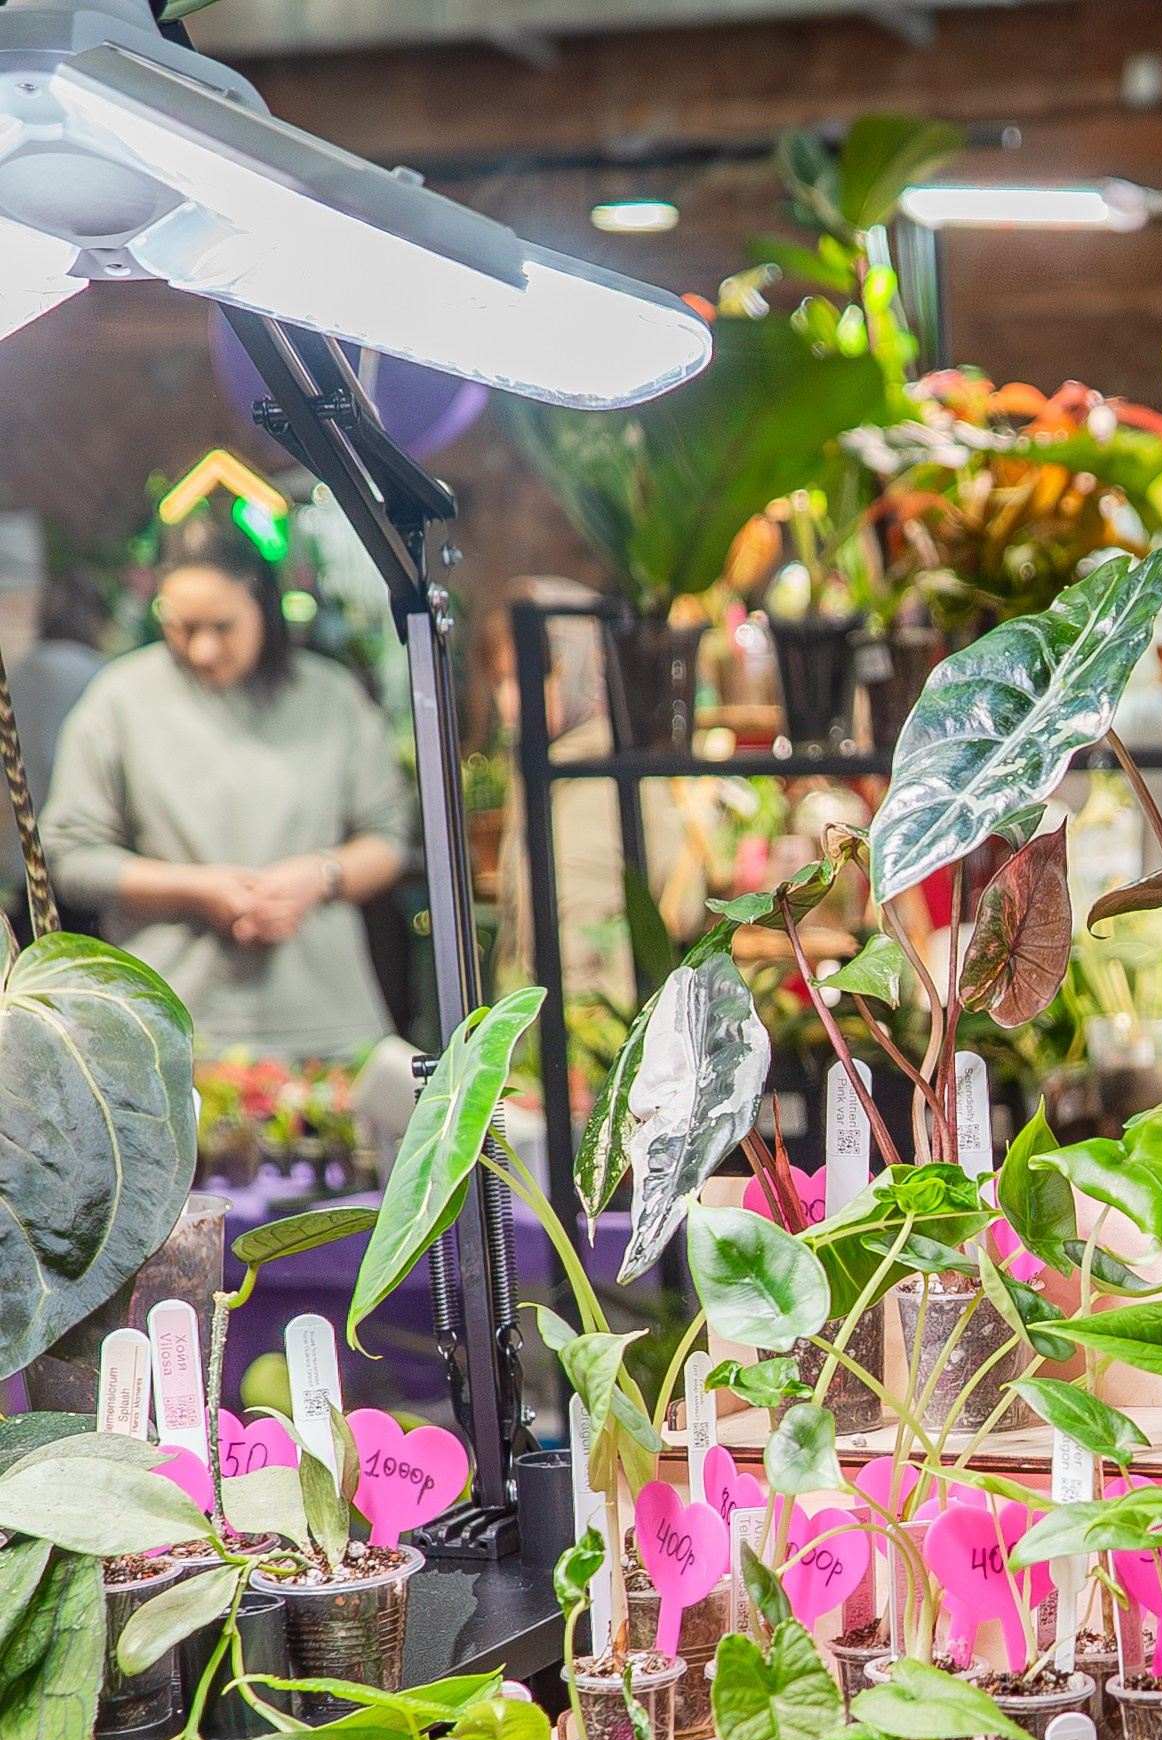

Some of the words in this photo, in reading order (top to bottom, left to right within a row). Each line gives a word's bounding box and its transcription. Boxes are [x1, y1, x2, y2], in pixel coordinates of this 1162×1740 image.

[836, 1077, 848, 1109] Pink
[836, 1110, 847, 1127] var
[174, 1334, 189, 1371] Хойя
[118, 1387, 131, 1423] Splash
